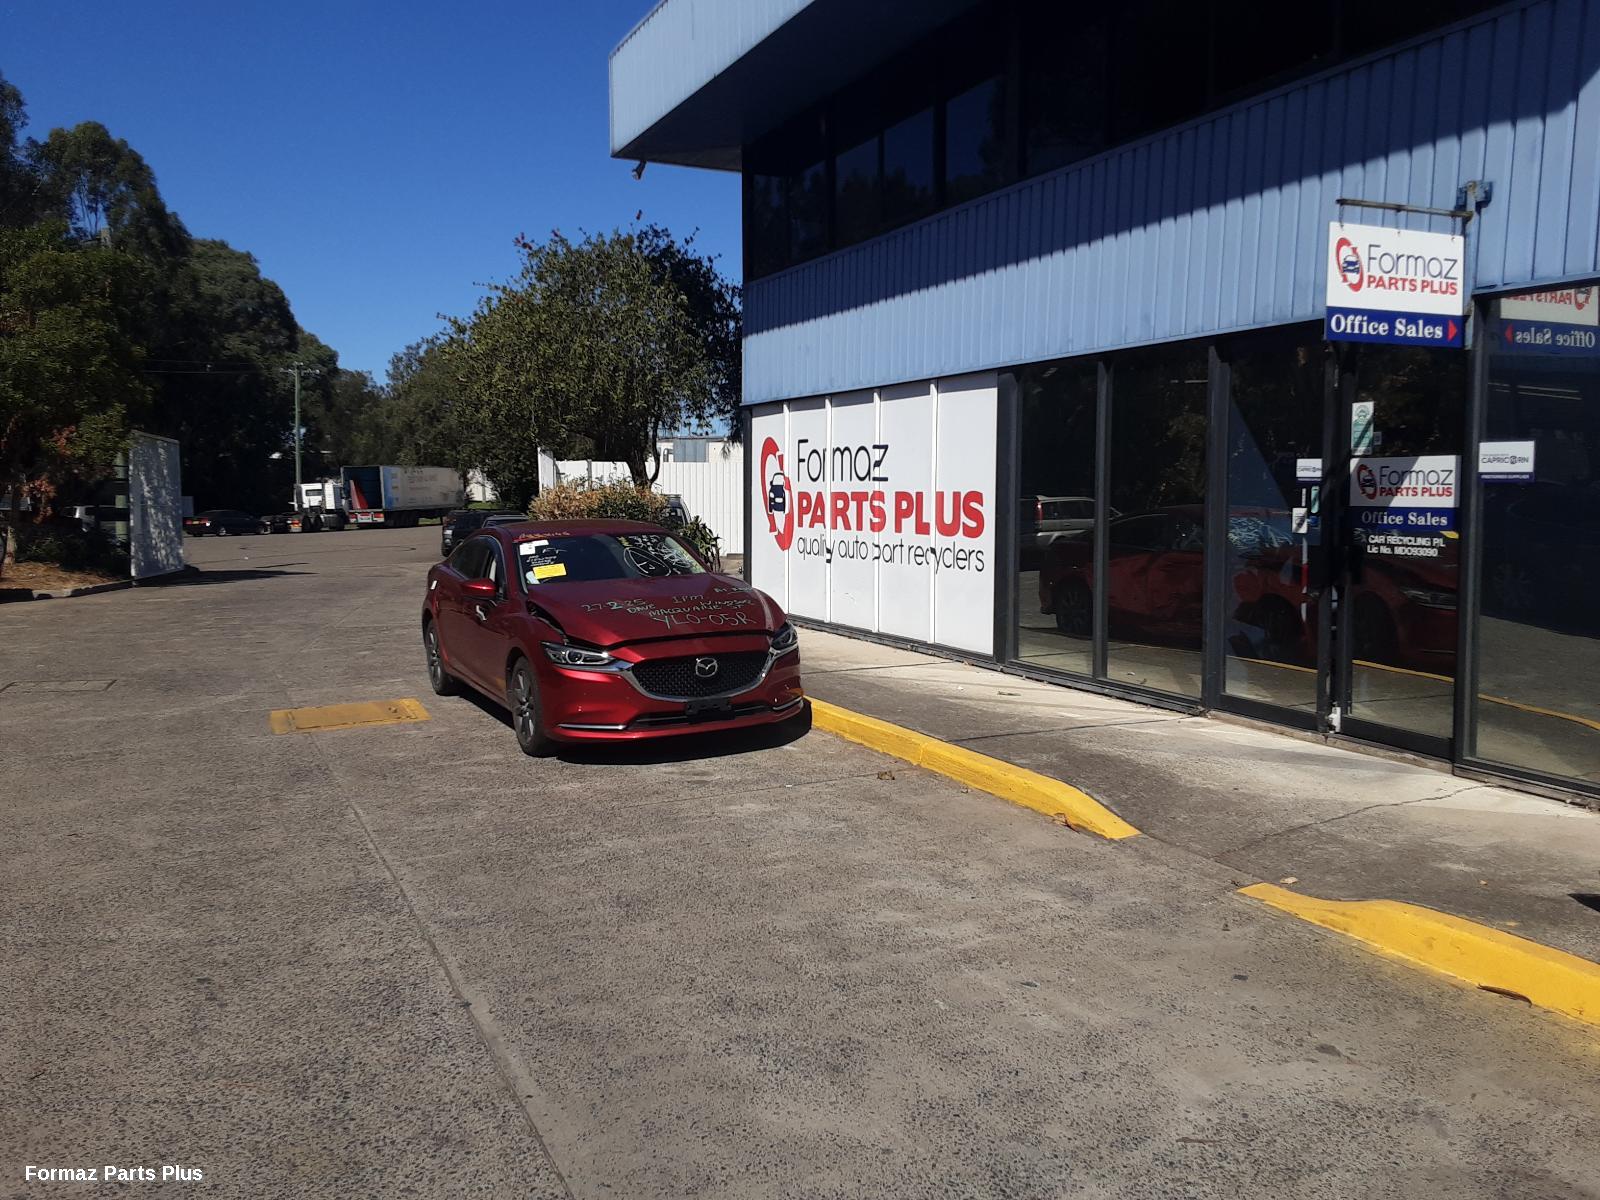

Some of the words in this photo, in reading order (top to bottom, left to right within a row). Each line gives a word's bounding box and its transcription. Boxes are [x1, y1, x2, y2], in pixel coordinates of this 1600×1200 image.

[1367, 243, 1458, 280] Formaz
[1367, 273, 1417, 292] PARTS
[1420, 278, 1457, 295] PLUS
[1330, 313, 1389, 336] Office
[1394, 317, 1443, 339] Sales
[797, 438, 889, 482] Formaz
[1379, 465, 1453, 486] Formaz
[1379, 486, 1418, 497] PARTS
[1421, 487, 1453, 497] PLUS
[797, 490, 886, 533] PARTS
[894, 490, 985, 539] PLUS
[1361, 511, 1403, 525] Office
[1407, 512, 1448, 526] Sales
[1367, 545, 1378, 553] Lic
[1368, 535, 1385, 543] CAR
[1387, 535, 1431, 545] RECYCLING
[797, 534, 836, 564] qualiy
[838, 535, 868, 560] auto
[908, 541, 985, 574] recyclers
